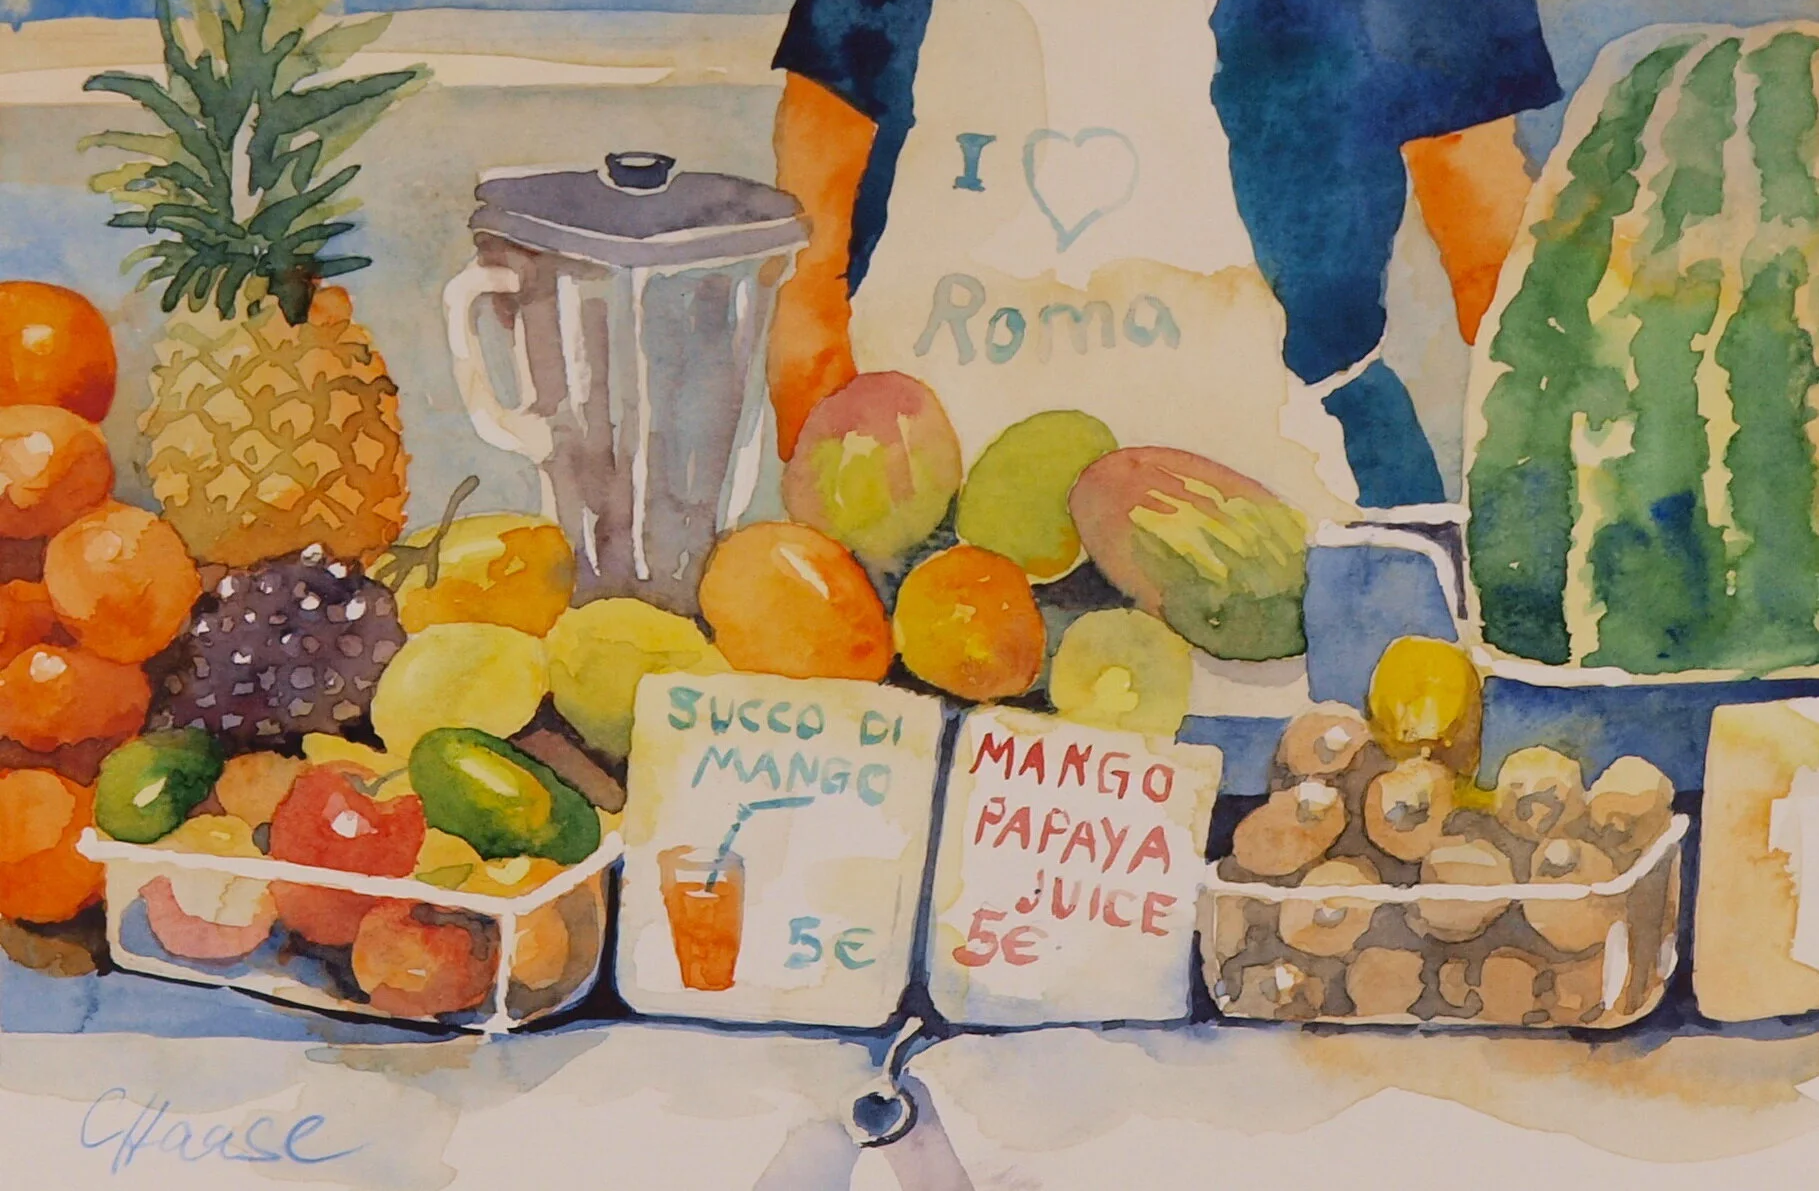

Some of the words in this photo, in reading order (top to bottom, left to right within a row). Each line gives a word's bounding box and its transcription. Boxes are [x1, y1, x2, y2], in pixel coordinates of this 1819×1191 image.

[952, 133, 997, 192] I
[913, 273, 1182, 366] Roma
[668, 687, 825, 741] SUCCO
[860, 709, 903, 747] DI
[692, 745, 892, 806] MANGO
[969, 732, 1174, 802] MANGO
[974, 796, 1171, 876] PAPAYA
[1015, 870, 1178, 937] JUICE
[784, 916, 876, 970] 5€
[952, 909, 1048, 967] 5€
